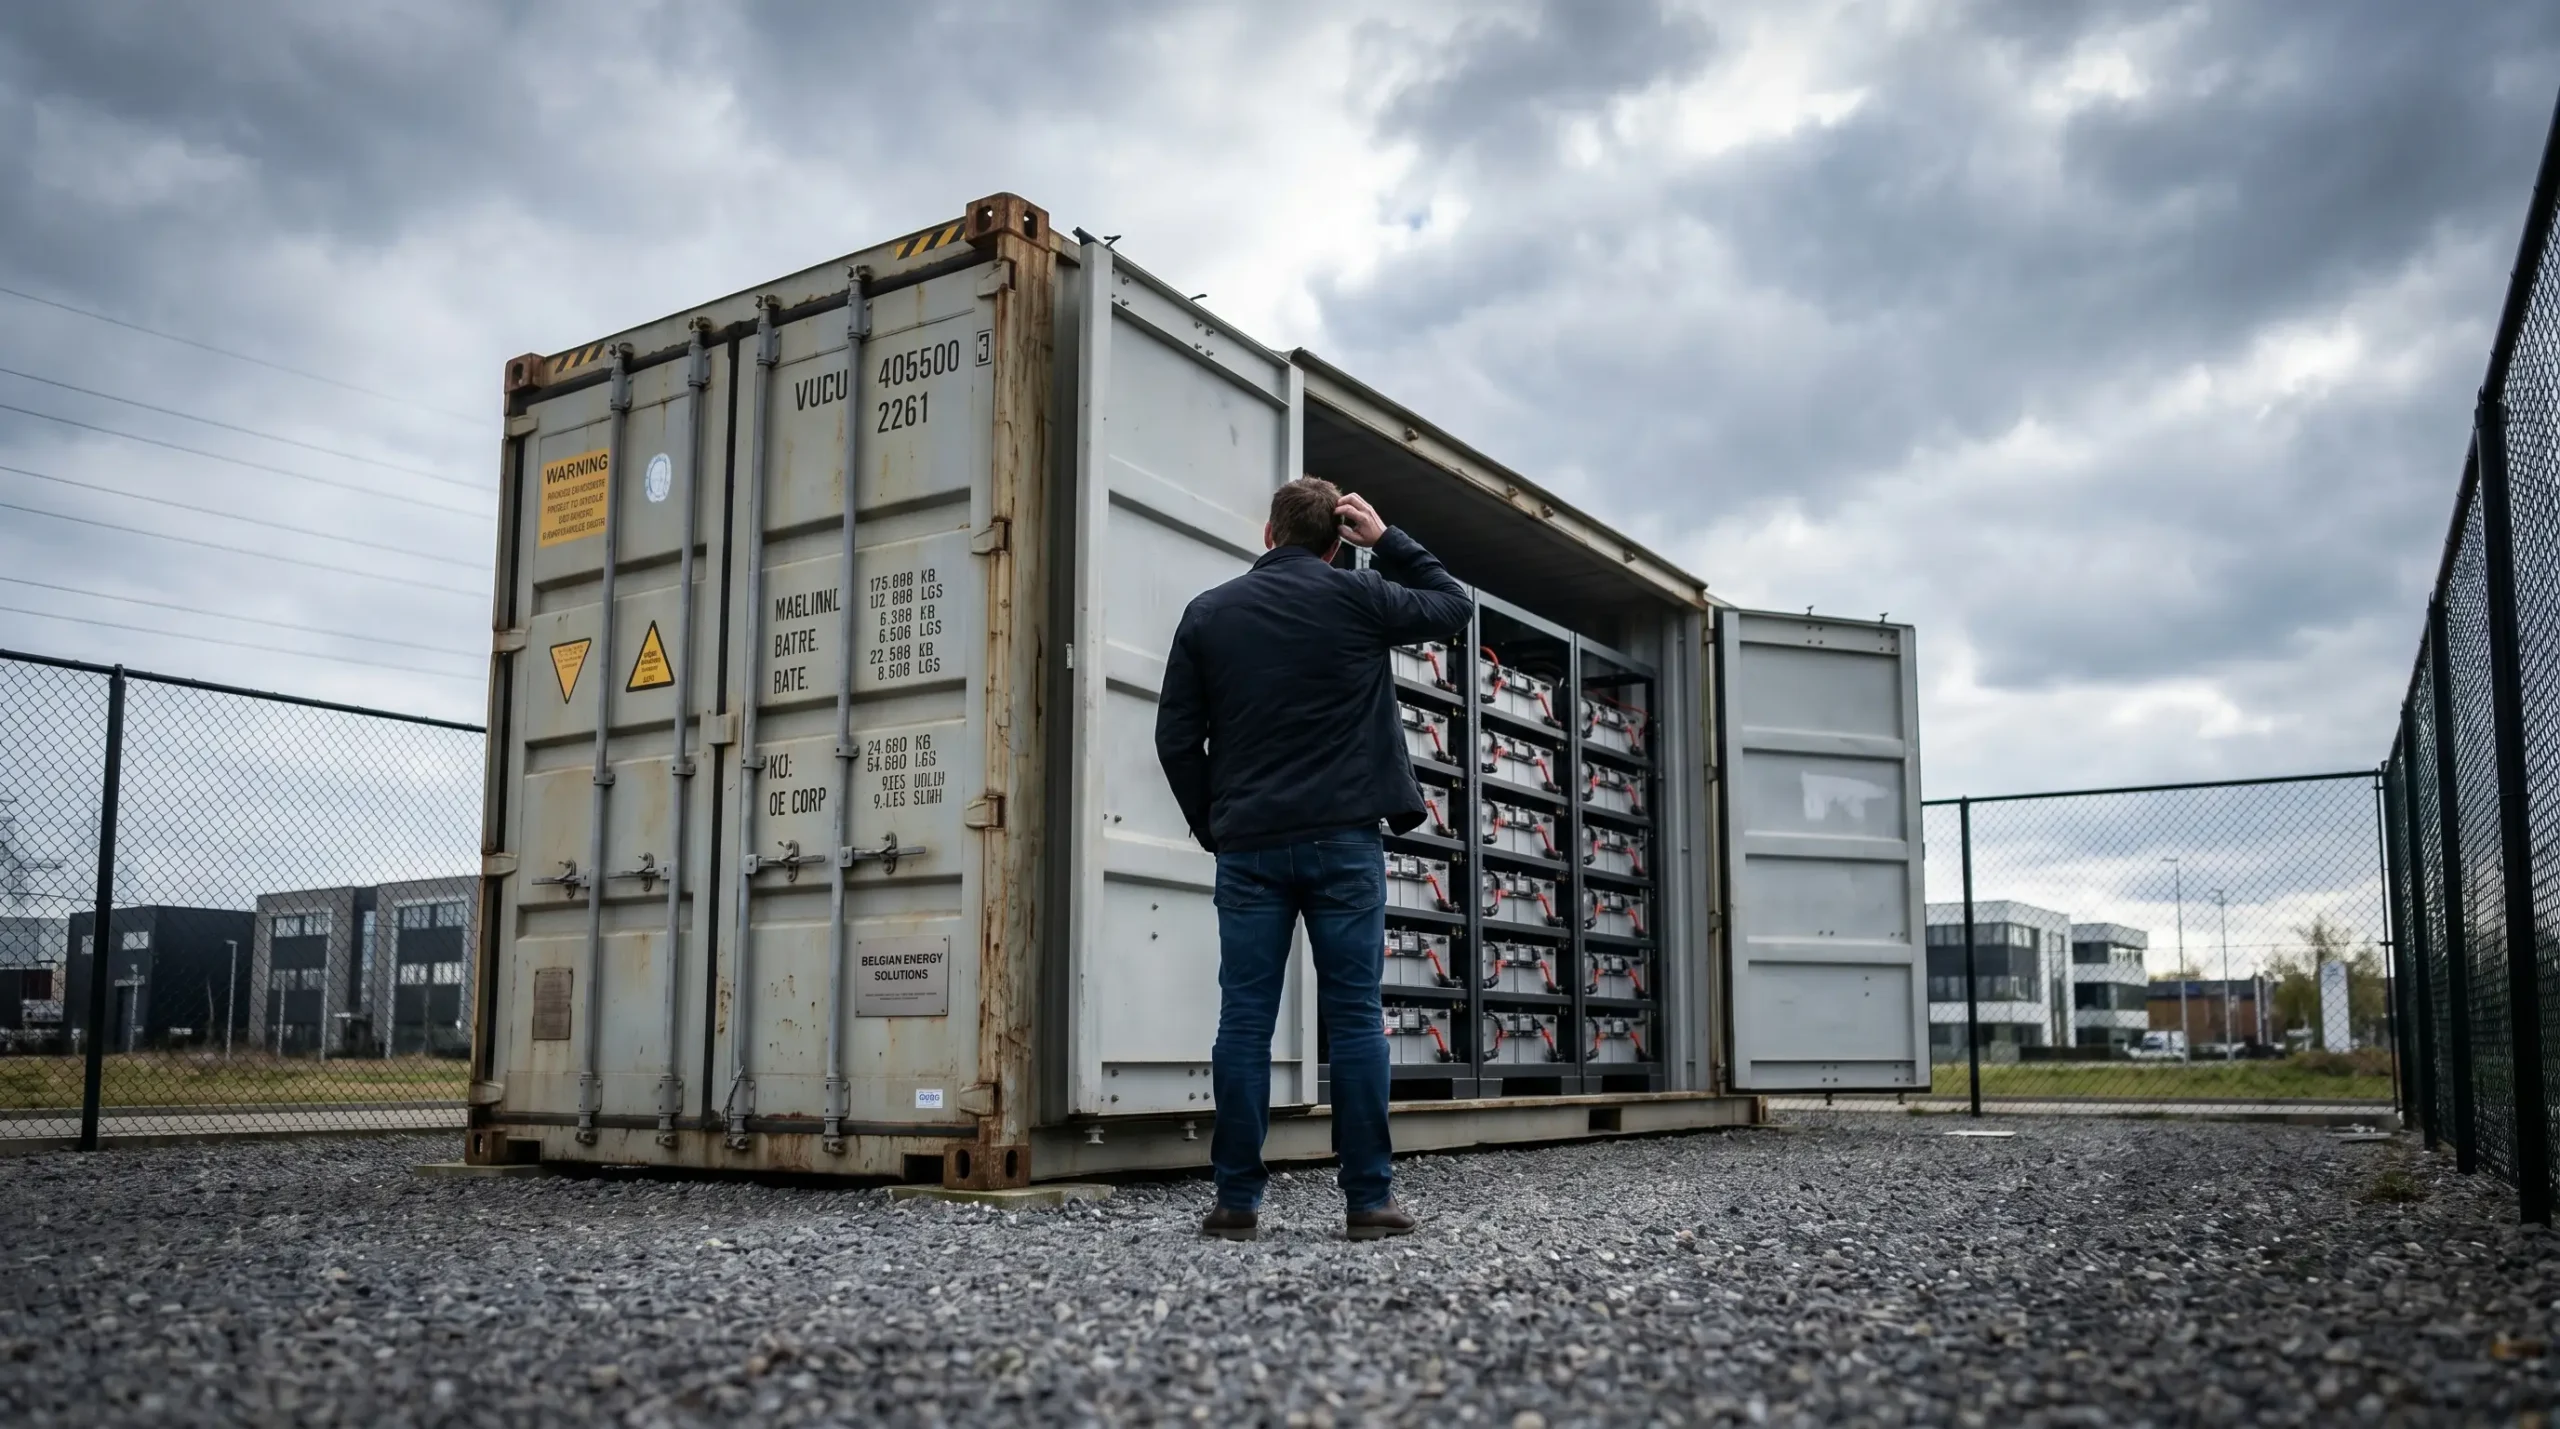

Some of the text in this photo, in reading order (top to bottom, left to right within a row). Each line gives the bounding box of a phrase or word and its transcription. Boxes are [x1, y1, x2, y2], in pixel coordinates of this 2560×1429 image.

[878, 339, 960, 388] 405500
[978, 333, 990, 363] 3
[877, 391, 928, 434] 2261
[546, 454, 608, 485] WARNING
[921, 583, 943, 601] LGS
[920, 620, 942, 637] LGS
[919, 657, 941, 674] LGS
[769, 787, 827, 816] OE CORP
[861, 952, 943, 966] BELGIAN ENERGY
[874, 969, 929, 981] SOLUTIONS
